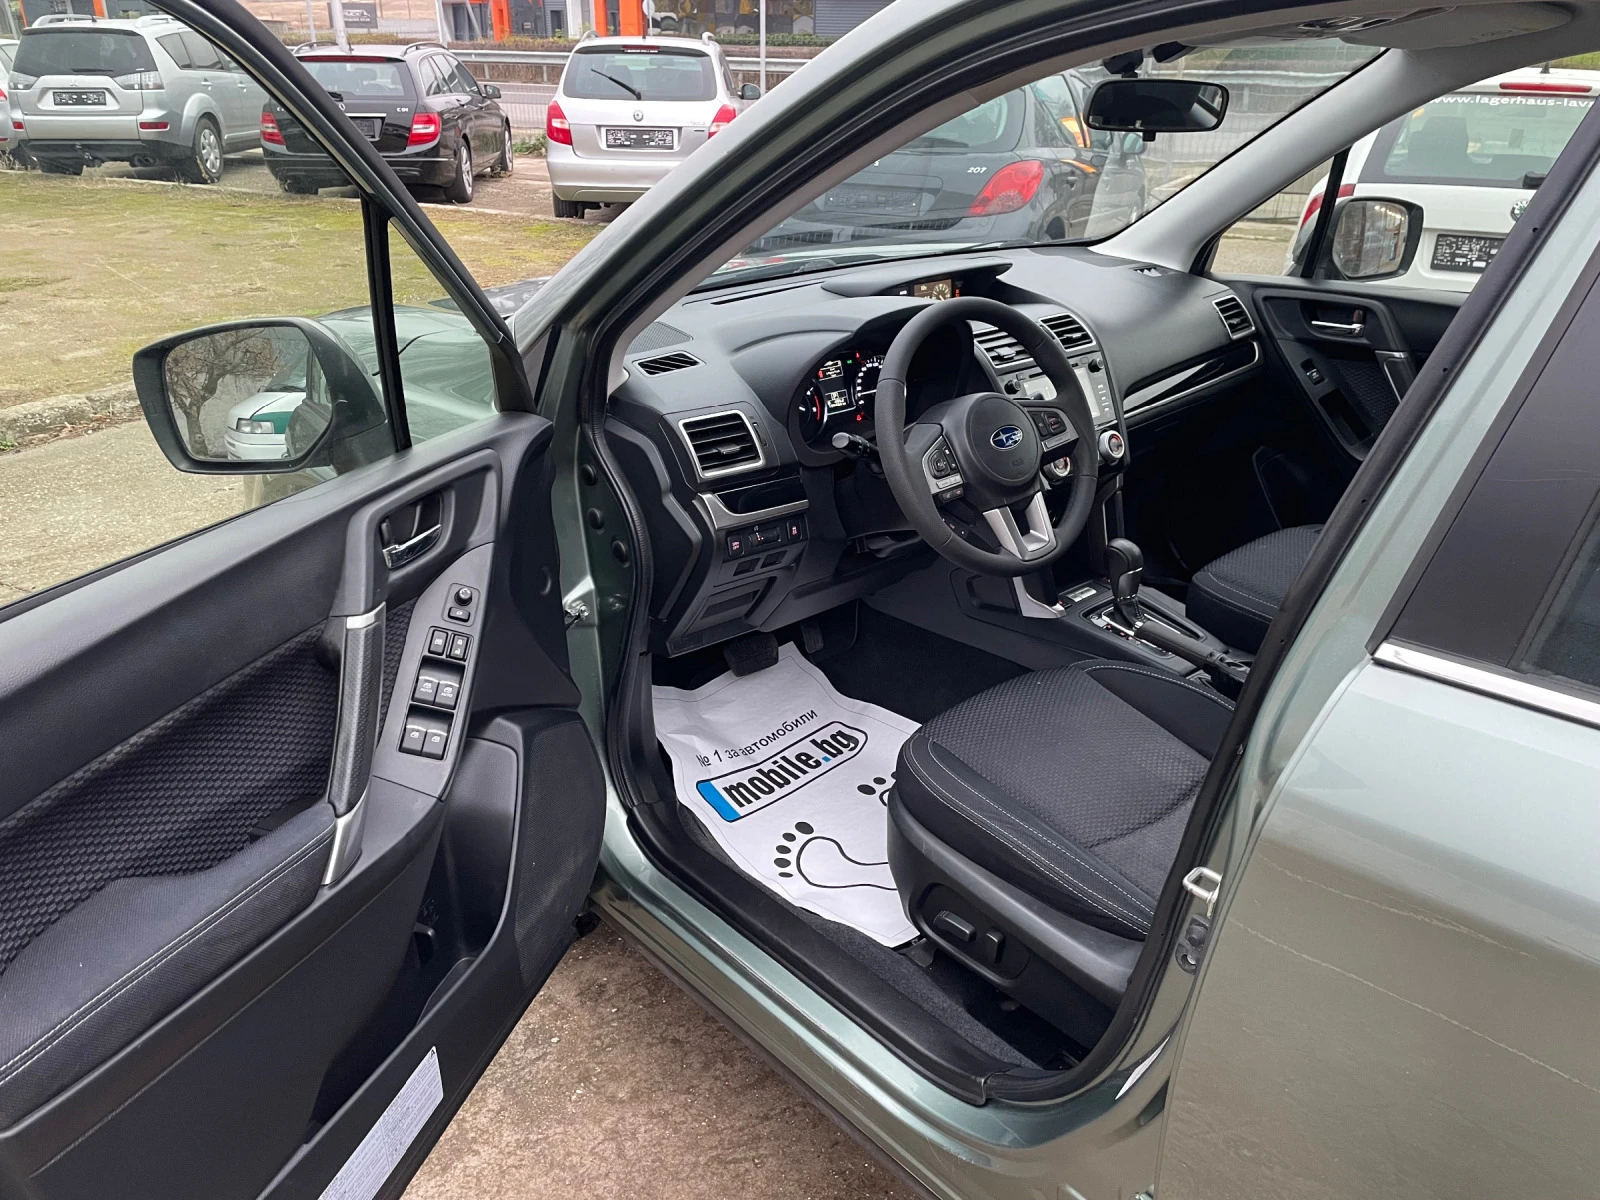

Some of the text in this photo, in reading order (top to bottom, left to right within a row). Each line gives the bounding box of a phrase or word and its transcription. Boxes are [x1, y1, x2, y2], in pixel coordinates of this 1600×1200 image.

[966, 166, 988, 174] 207
[713, 749, 723, 763] 1
[738, 709, 818, 757] автомобили
[722, 729, 860, 808] mobile.bg
